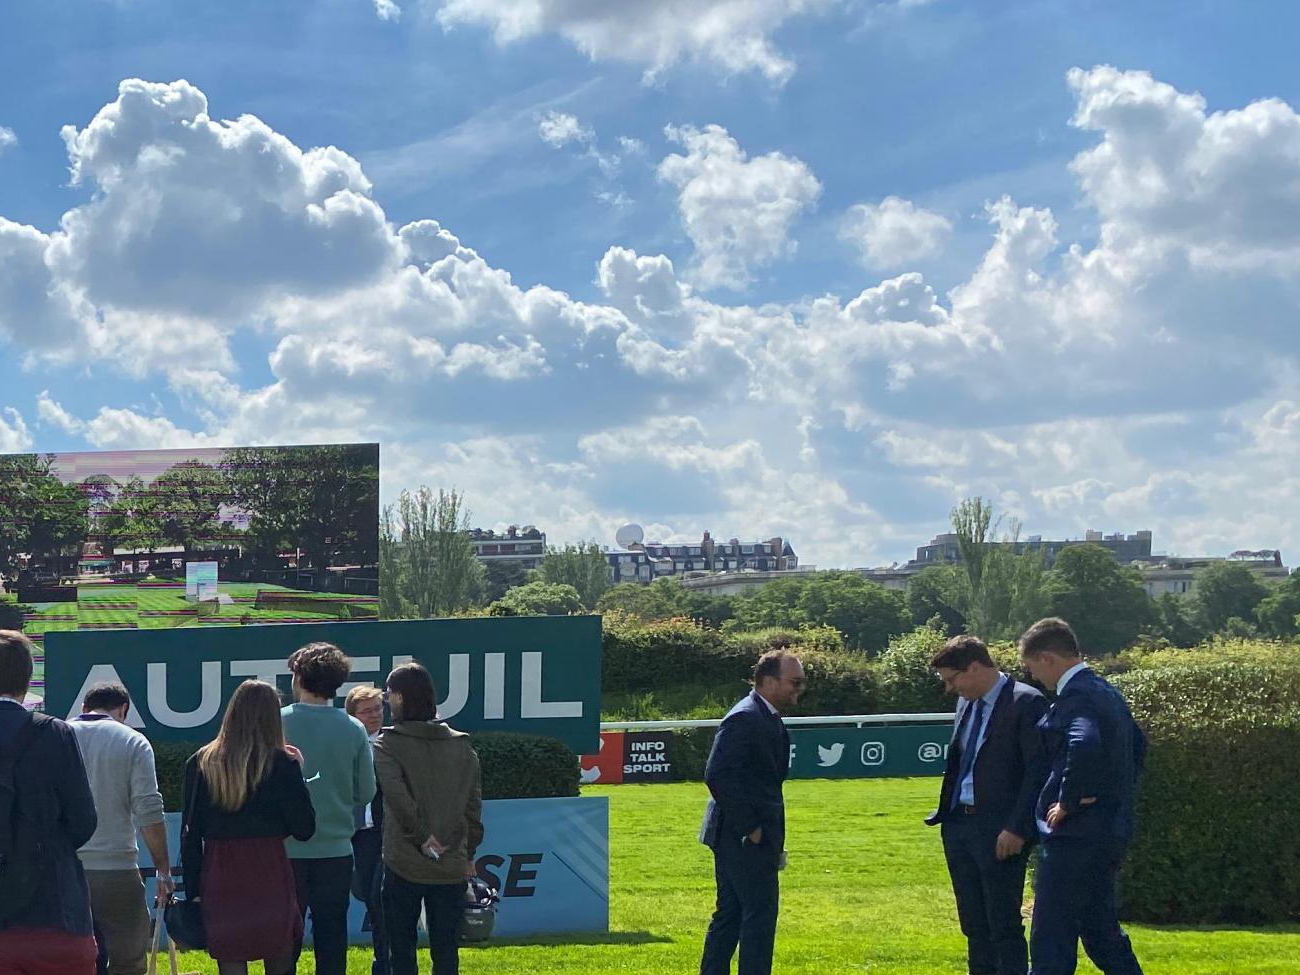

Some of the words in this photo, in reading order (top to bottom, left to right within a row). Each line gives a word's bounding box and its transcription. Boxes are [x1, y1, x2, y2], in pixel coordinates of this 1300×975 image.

[631, 741, 665, 751] INFO
[629, 752, 666, 763] TALK
[623, 763, 671, 774] SPORT
